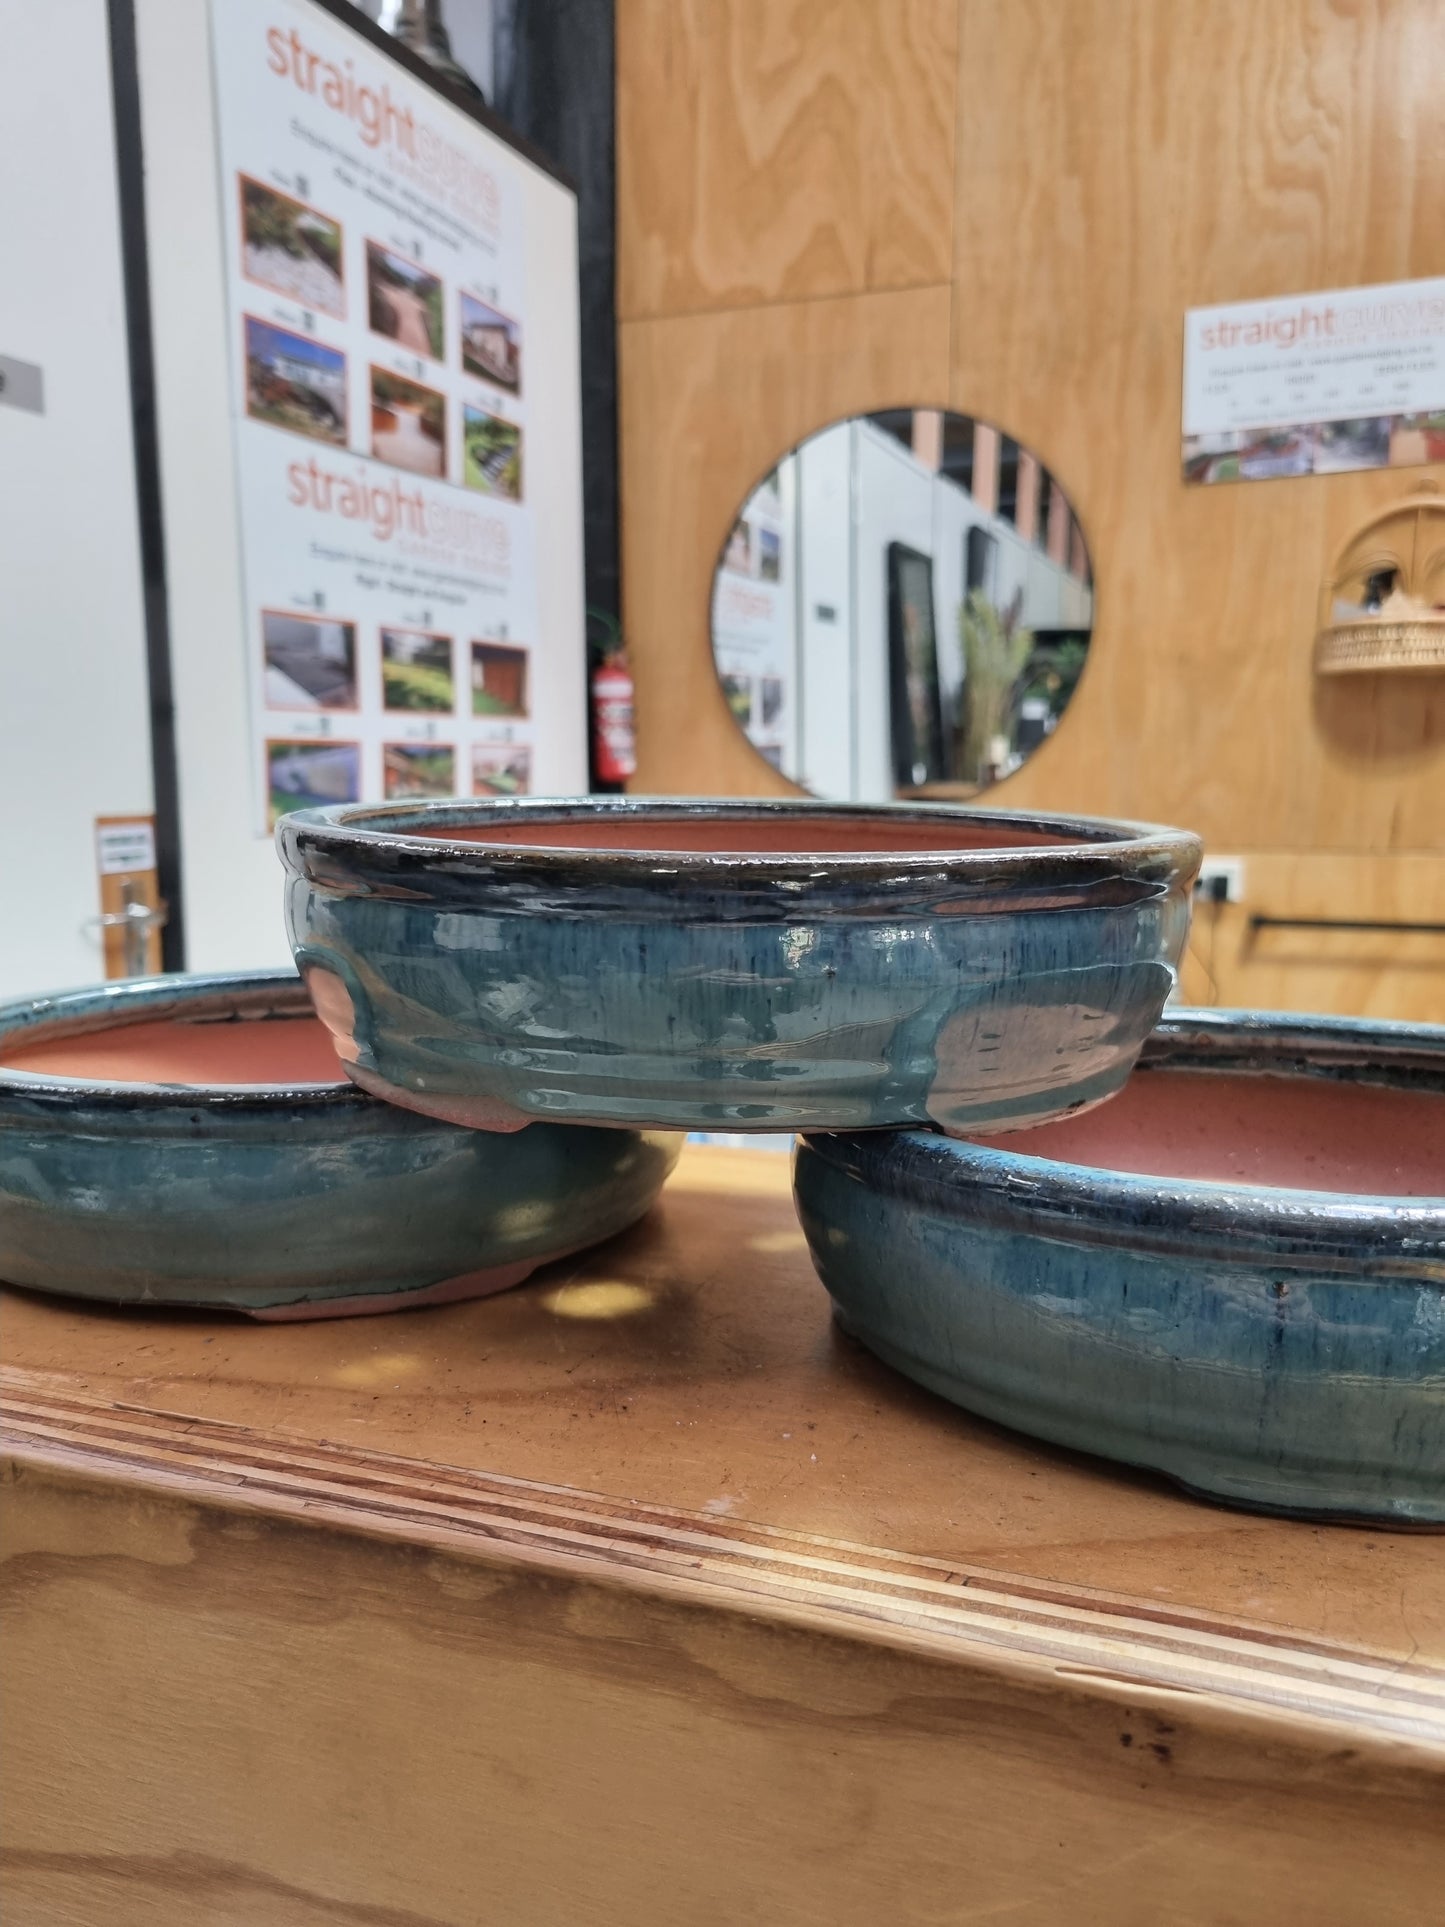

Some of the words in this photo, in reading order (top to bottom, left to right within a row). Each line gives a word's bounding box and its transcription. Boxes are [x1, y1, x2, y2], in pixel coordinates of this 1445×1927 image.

[266, 25, 418, 160] straight
[1200, 306, 1336, 350] straight
[287, 457, 427, 540] straight
